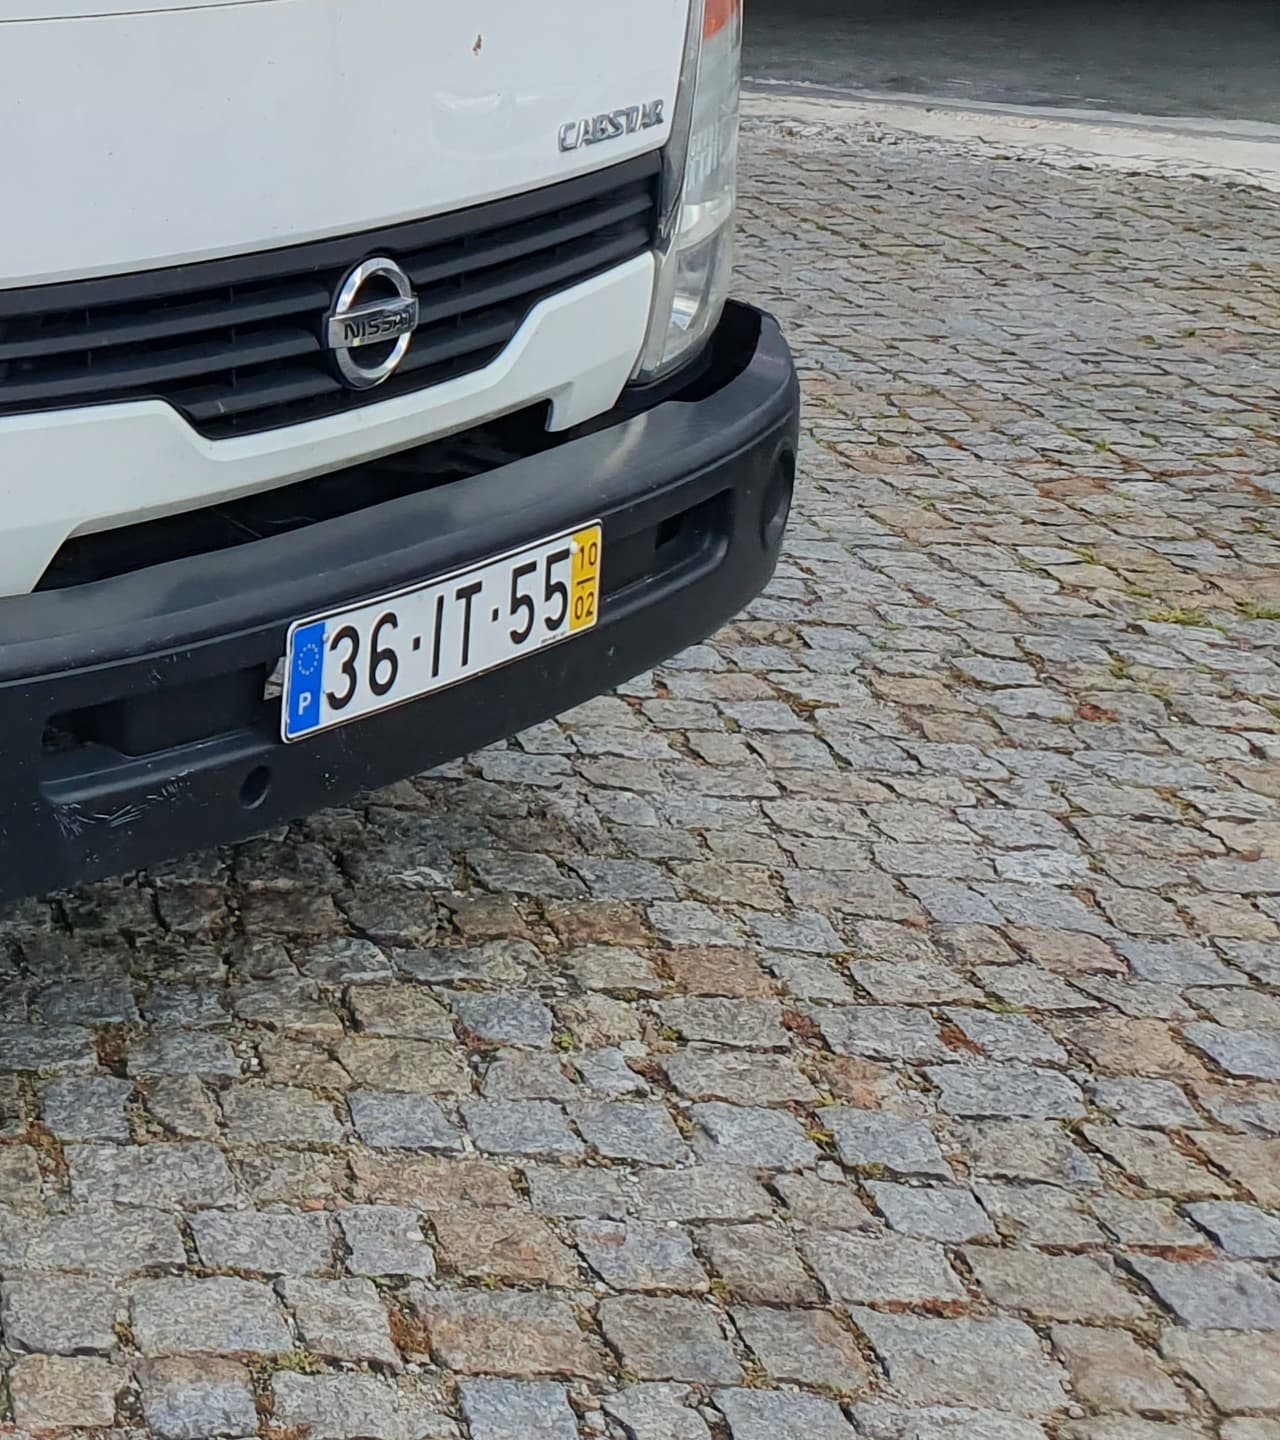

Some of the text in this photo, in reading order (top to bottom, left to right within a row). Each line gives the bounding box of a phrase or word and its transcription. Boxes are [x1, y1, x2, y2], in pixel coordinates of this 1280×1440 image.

[558, 99, 665, 153] CABSTAR
[343, 303, 415, 341] NISSAN
[578, 541, 598, 569] 10
[574, 591, 595, 621] 02
[298, 691, 312, 716] P
